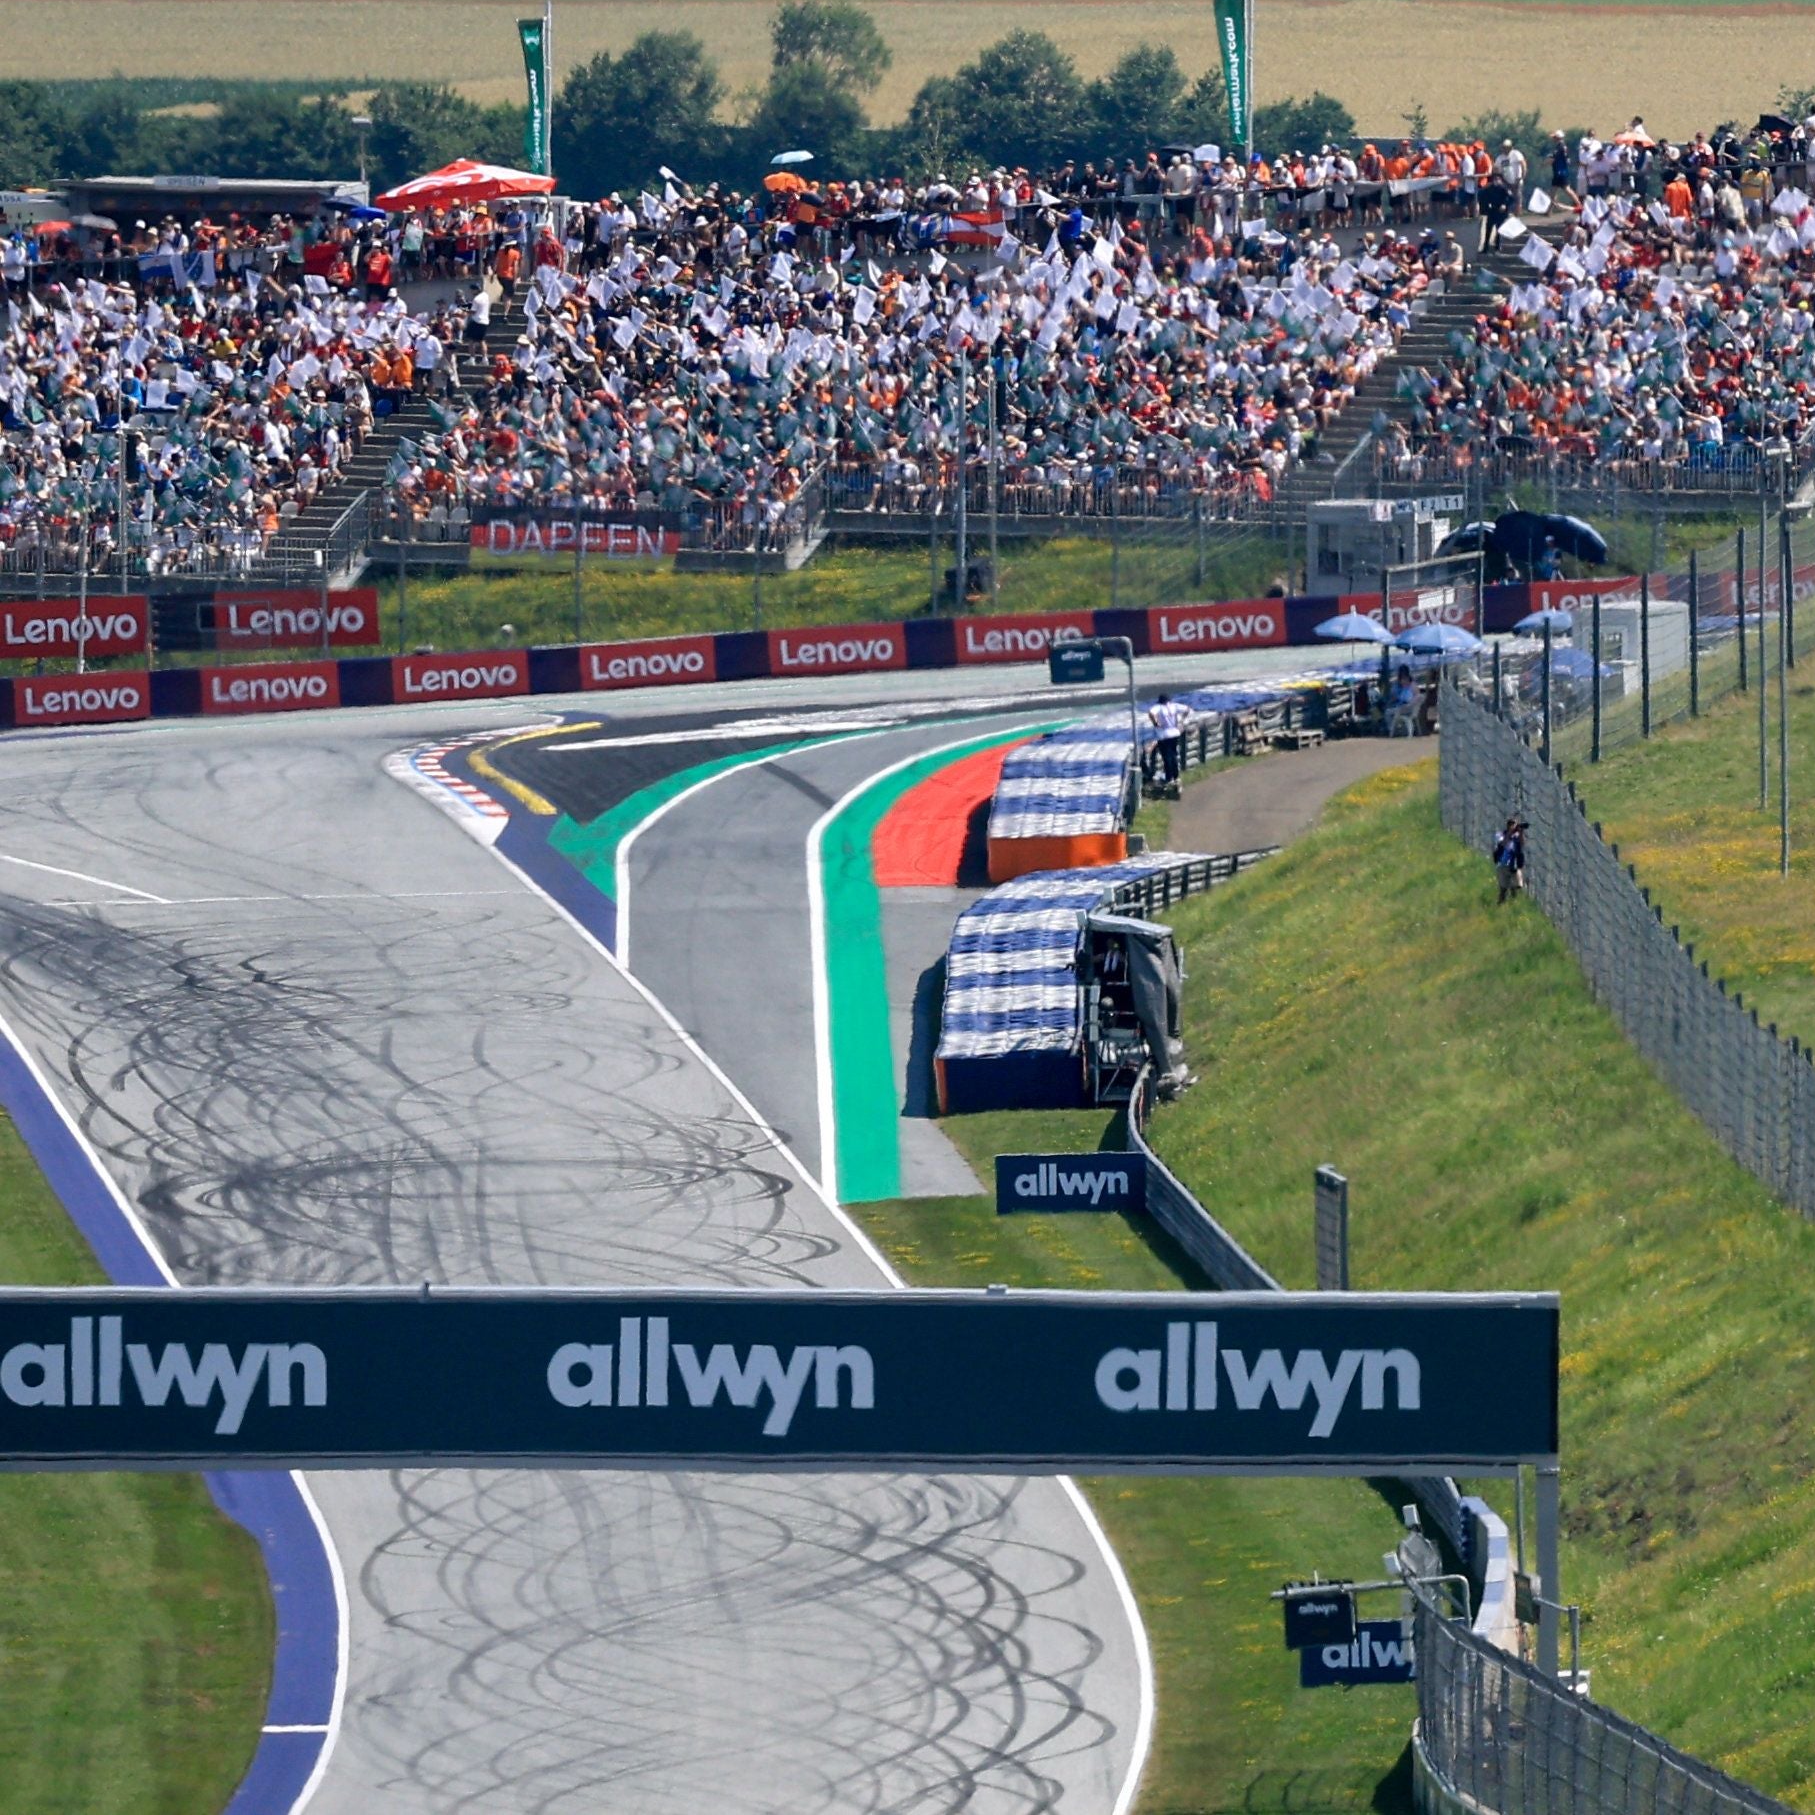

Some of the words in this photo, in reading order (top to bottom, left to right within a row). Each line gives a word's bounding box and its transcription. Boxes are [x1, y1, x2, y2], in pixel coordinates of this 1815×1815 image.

[5, 613, 138, 645] Lenovo
[229, 604, 365, 636] Lenovo
[1160, 613, 1275, 643] Lenovo
[590, 651, 705, 681] Lenovo
[780, 638, 893, 667] Lenovo
[211, 675, 328, 703] Lenovo
[404, 663, 518, 693] Lenovo
[25, 687, 140, 715] Lenovo
[1014, 1163, 1128, 1205] allwyn
[0, 1316, 328, 1436] allwyn
[546, 1316, 875, 1437] allwyn
[1094, 1321, 1421, 1438] allwyn
